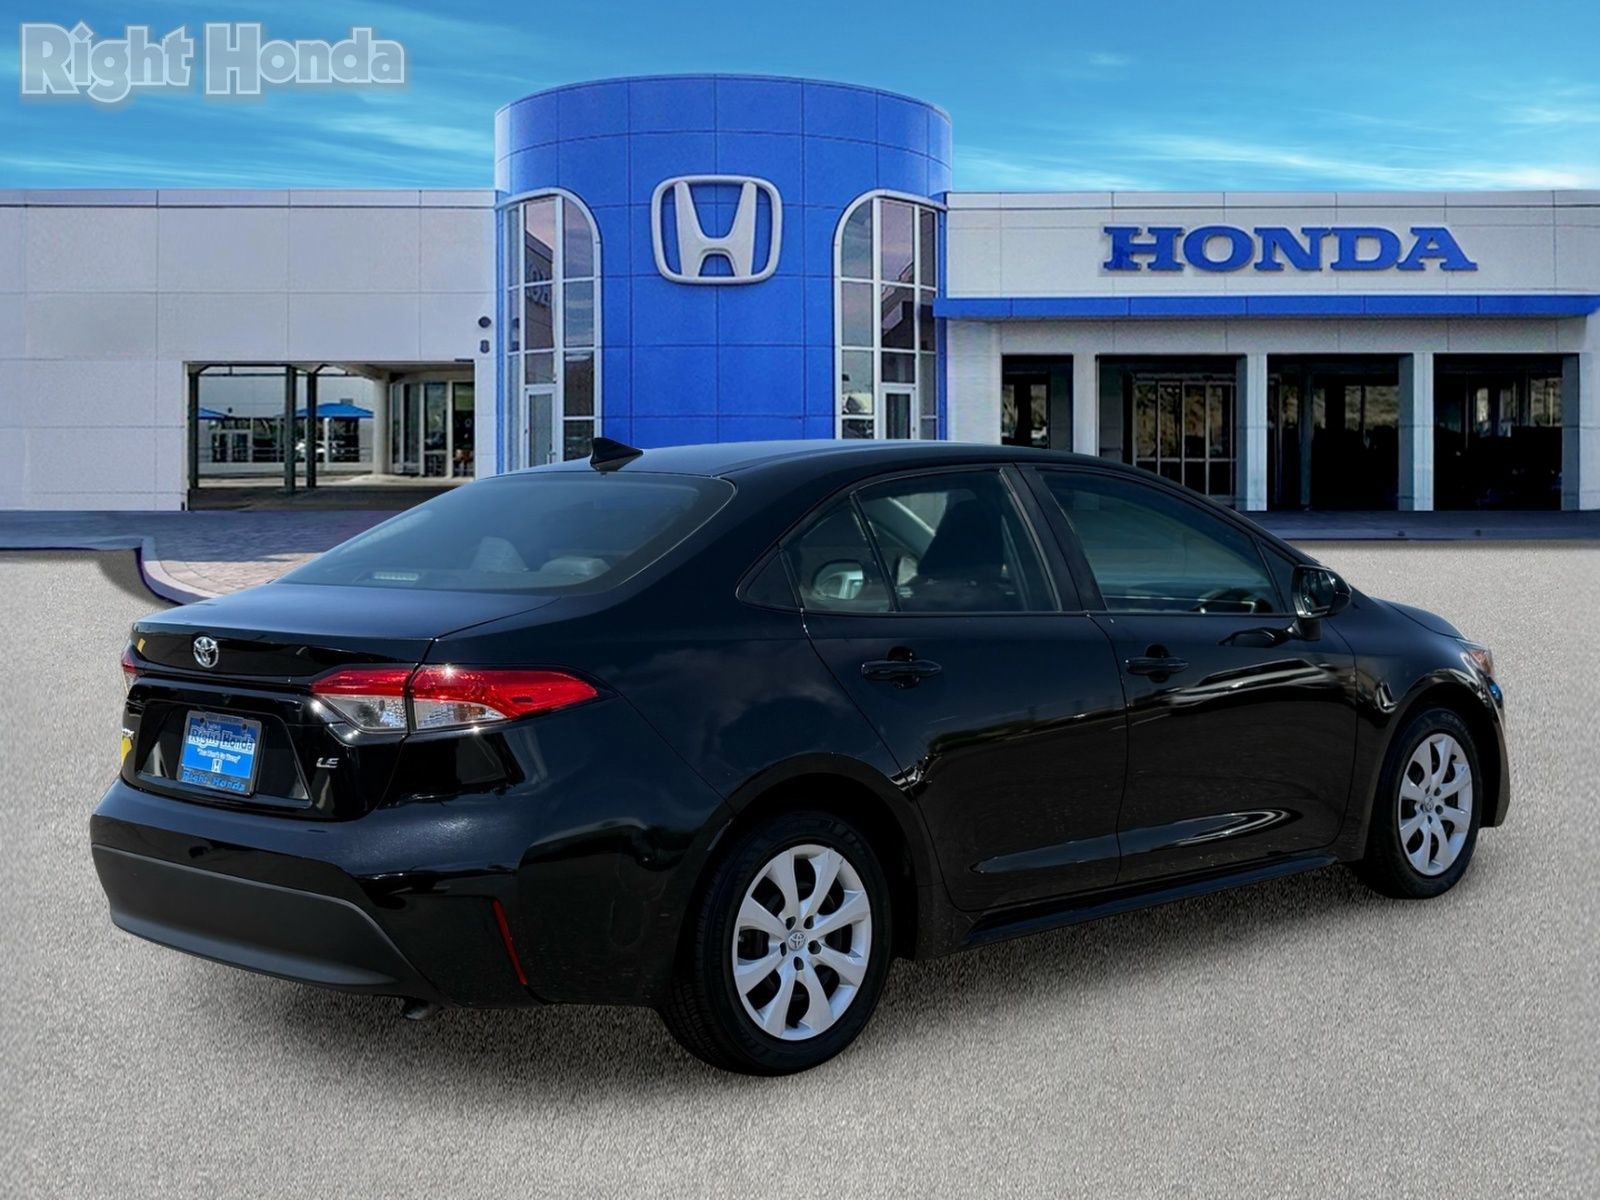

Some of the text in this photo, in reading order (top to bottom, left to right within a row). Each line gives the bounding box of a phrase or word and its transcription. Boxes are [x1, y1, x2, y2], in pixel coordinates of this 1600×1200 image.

[1103, 225, 1479, 272] HONDA
[190, 726, 220, 747] Right
[221, 730, 255, 752] Honda
[316, 757, 339, 768] LE
